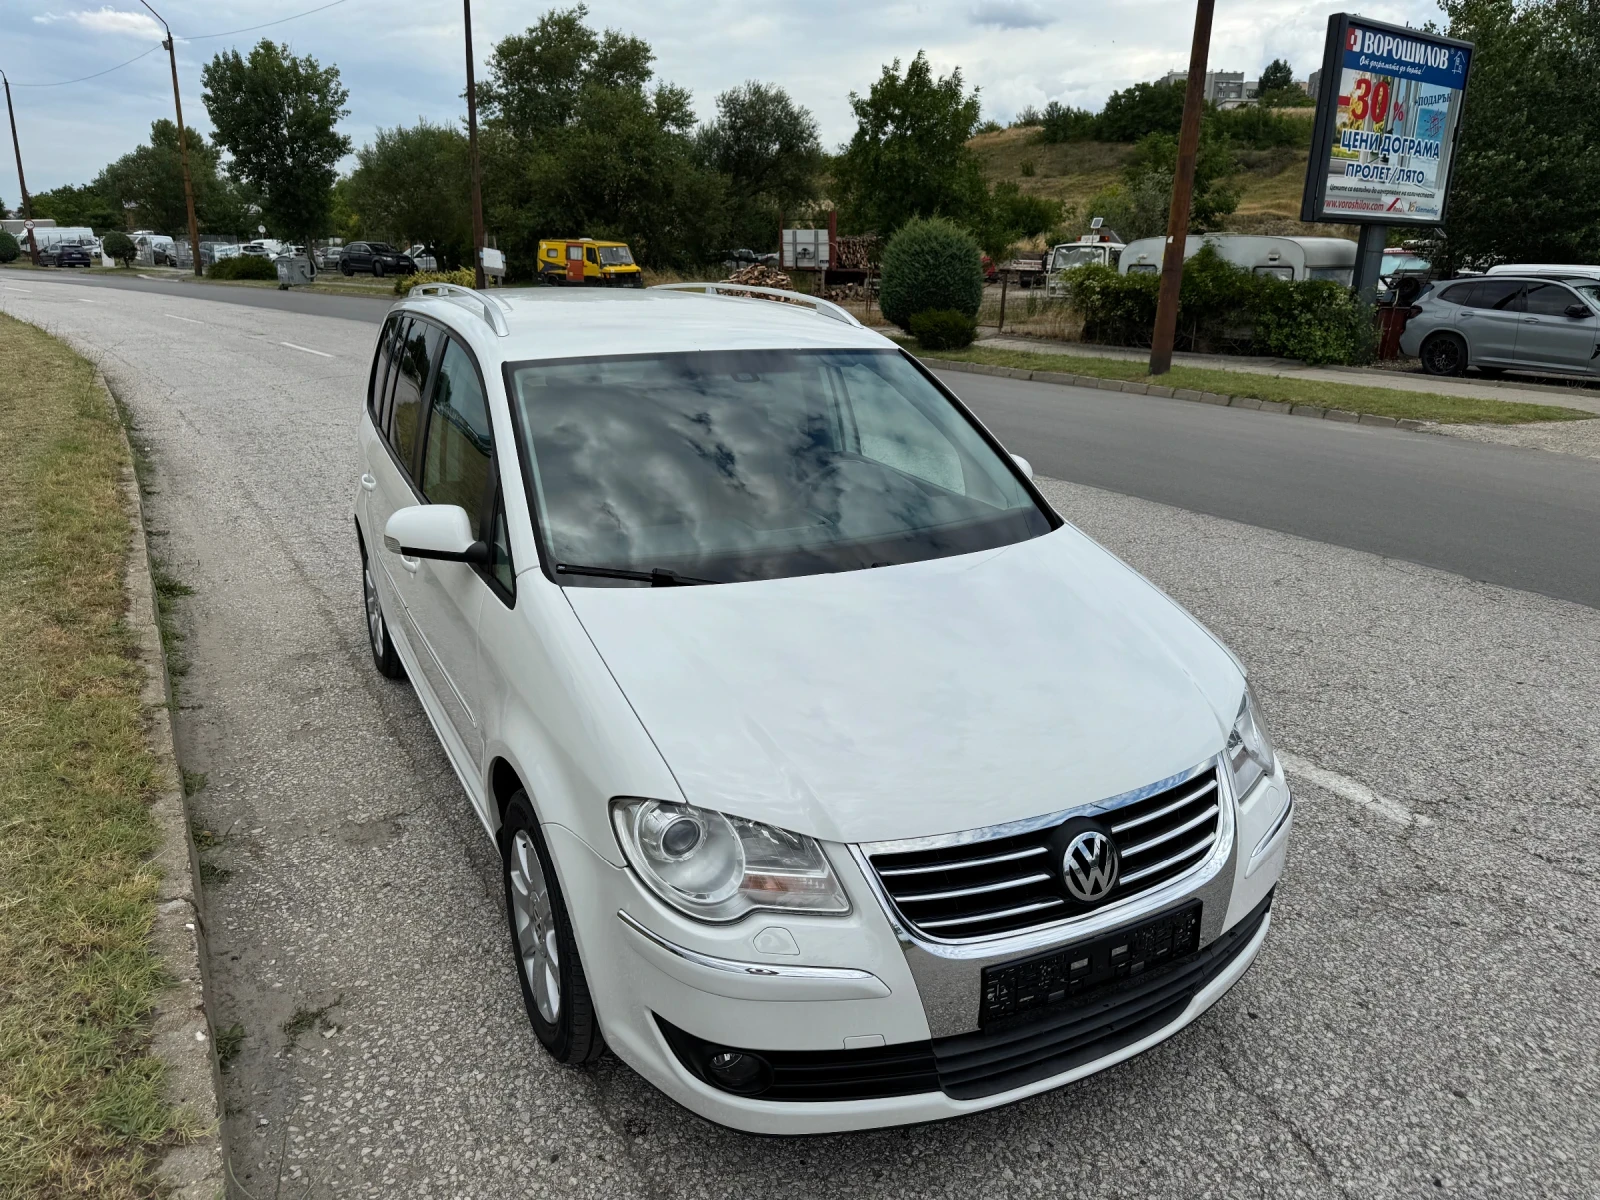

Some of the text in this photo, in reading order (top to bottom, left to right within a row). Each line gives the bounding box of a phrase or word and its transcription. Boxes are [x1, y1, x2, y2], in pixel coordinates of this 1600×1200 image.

[1363, 31, 1449, 69] ВОРОШИЛОВ
[1341, 129, 1440, 159] ЦЕНИ ДОГРАМА
[1324, 199, 1385, 212] ww.voroshilov.com
